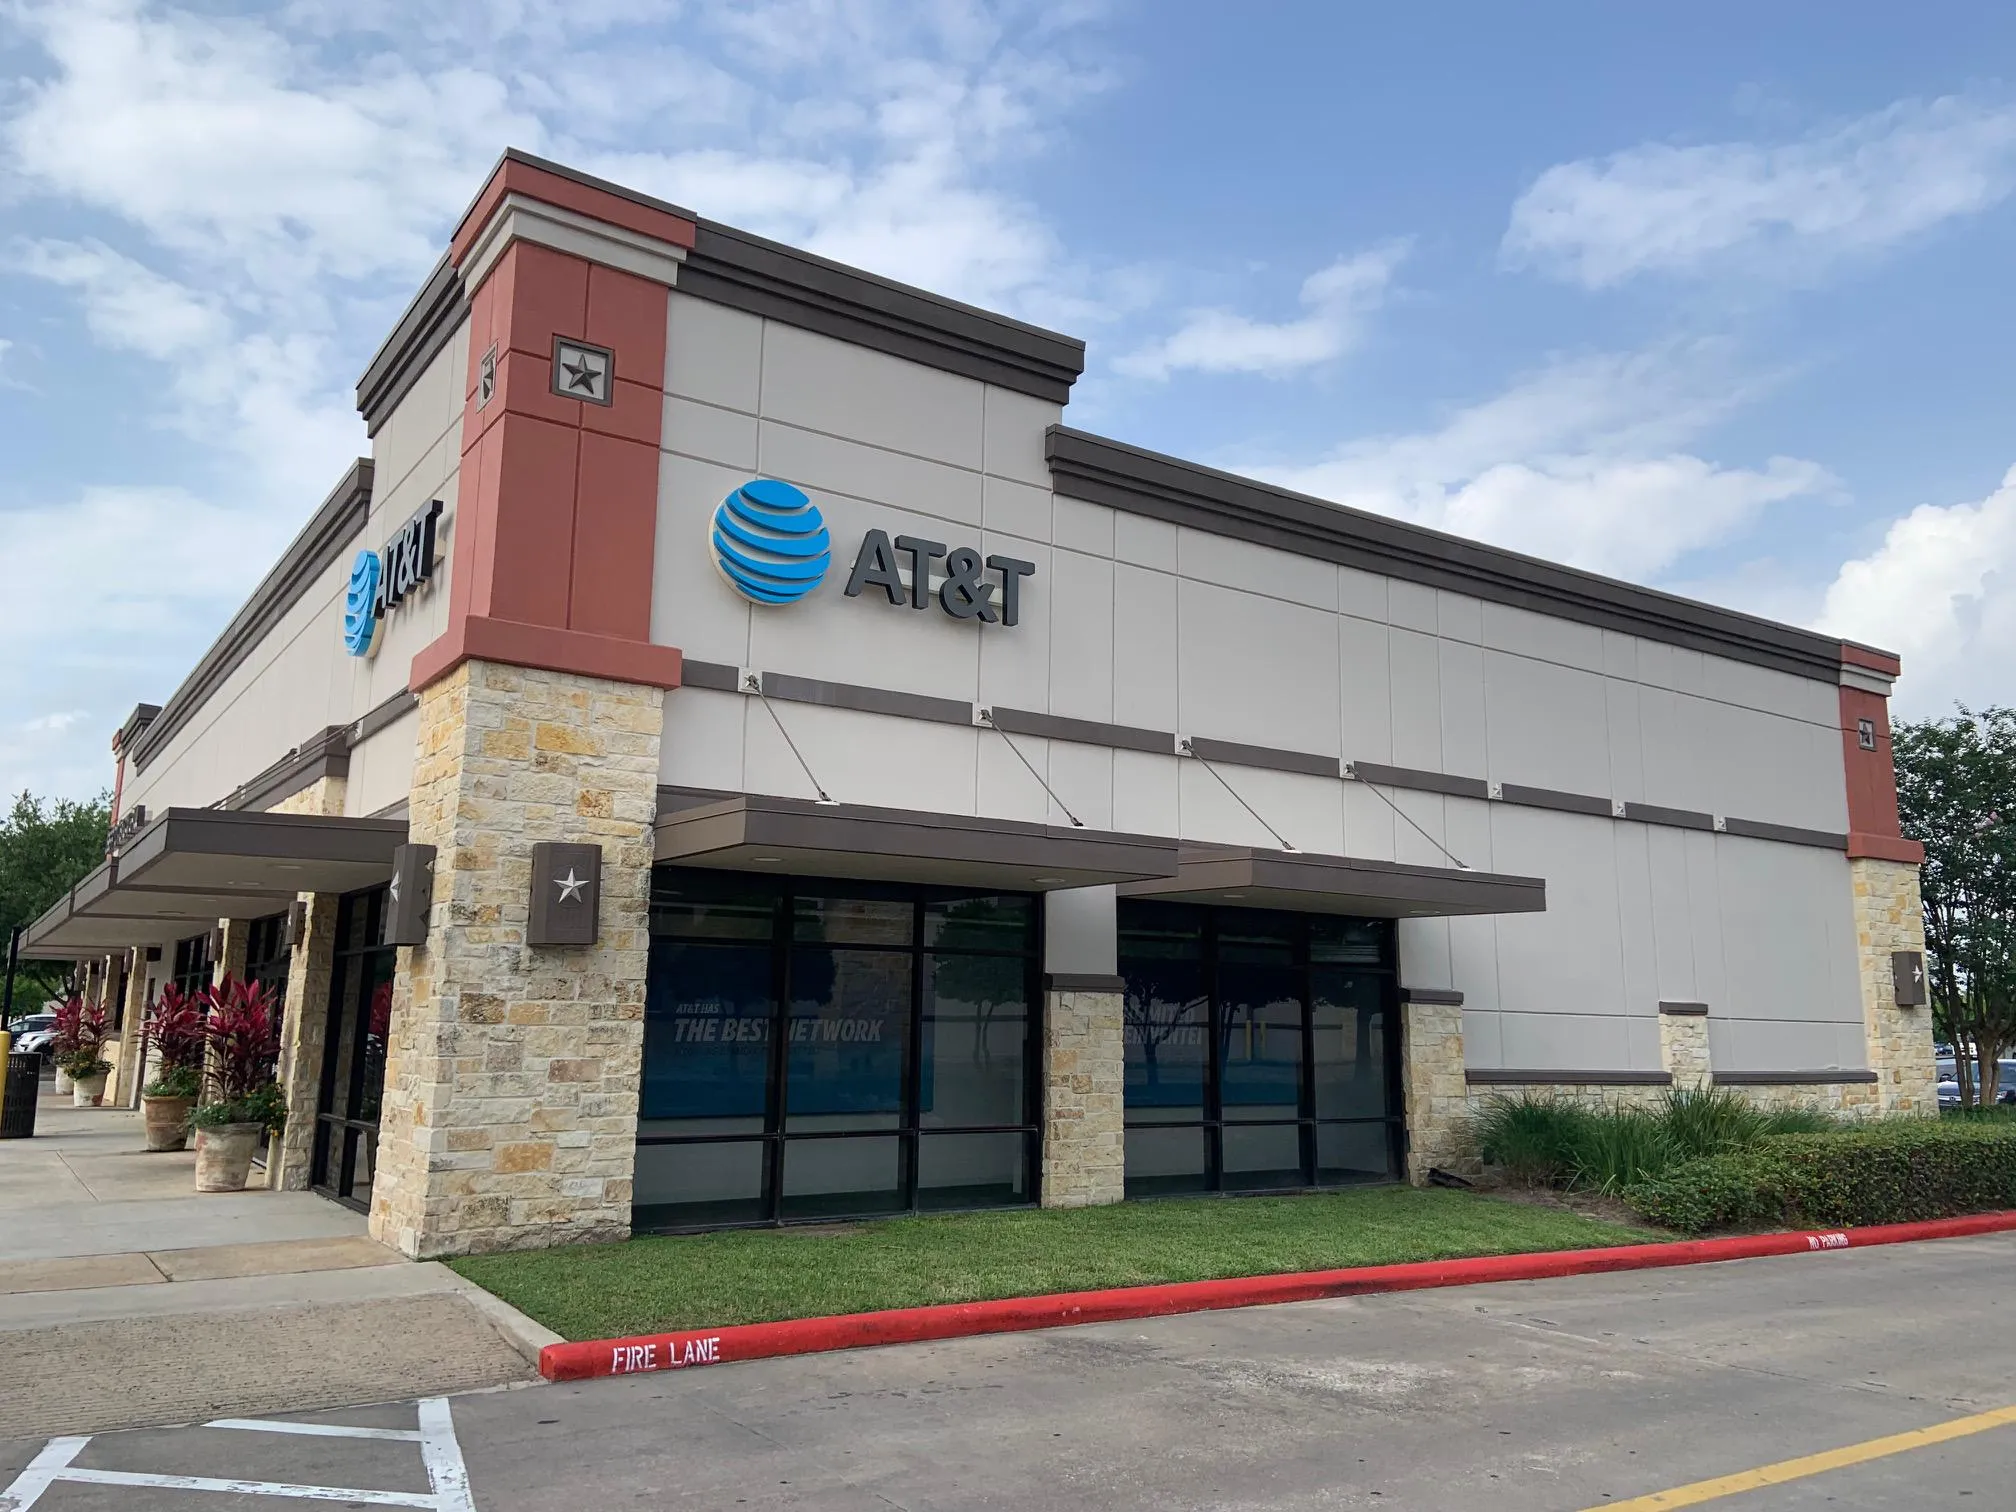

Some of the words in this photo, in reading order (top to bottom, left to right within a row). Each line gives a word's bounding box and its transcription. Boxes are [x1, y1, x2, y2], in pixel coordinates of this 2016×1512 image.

[371, 499, 443, 619] AT&T
[843, 528, 1035, 626] AT&T
[675, 1003, 700, 1014] AT&T
[700, 1003, 720, 1014] HAS
[674, 1018, 720, 1042] THE
[1806, 1235, 1819, 1250] NO
[1818, 1232, 1849, 1248] PARKING
[612, 1343, 657, 1373] FIRE
[669, 1337, 720, 1363] LANE
